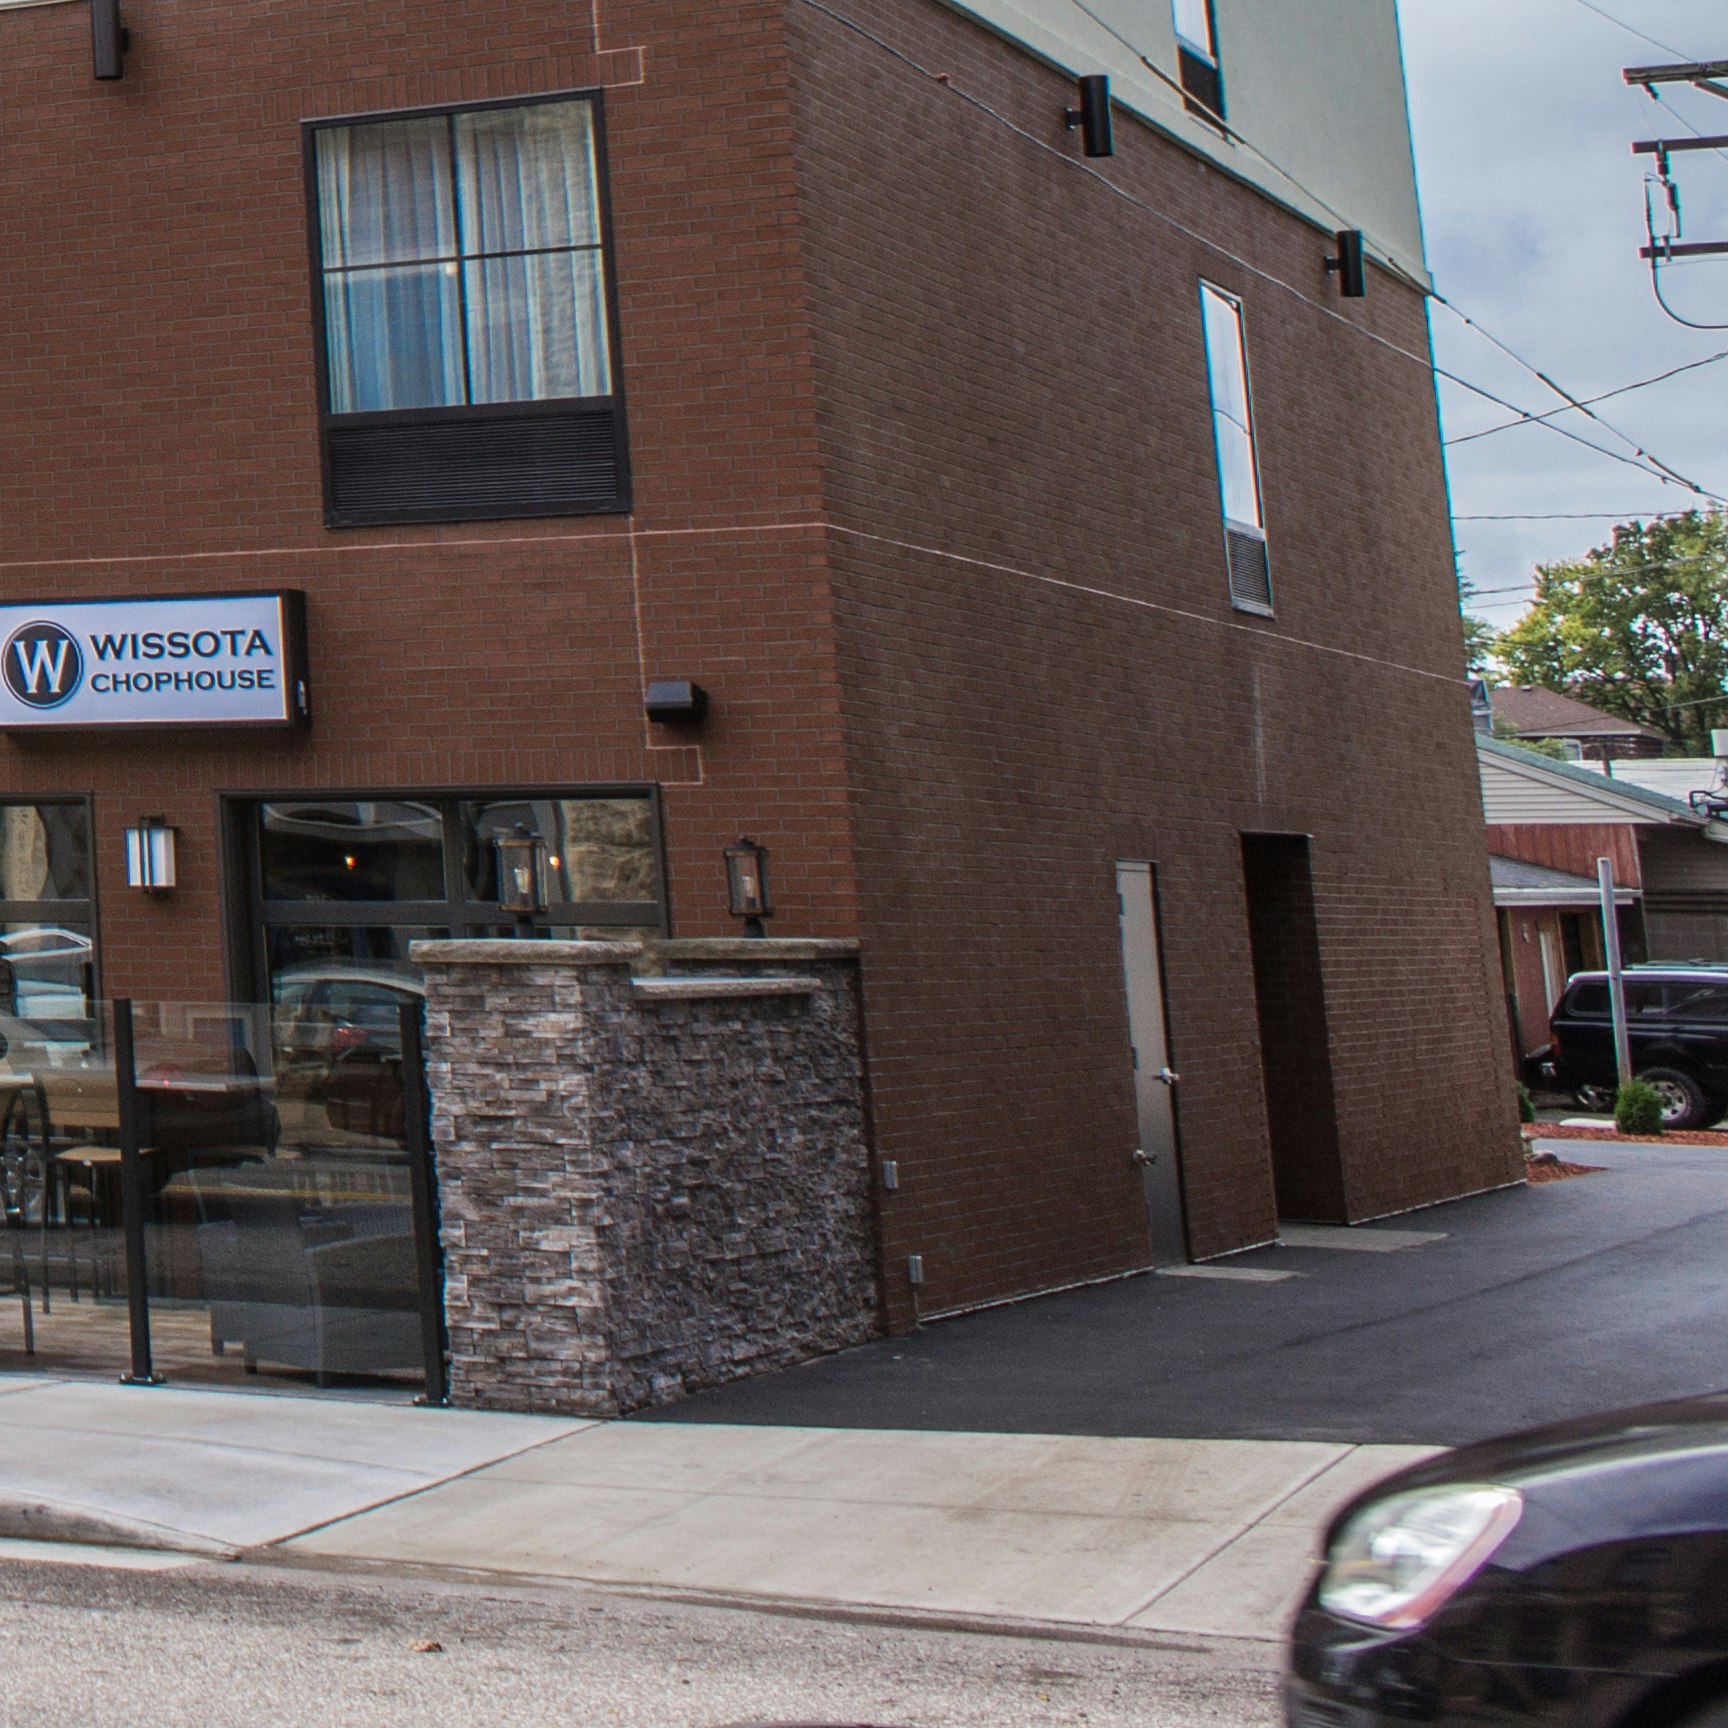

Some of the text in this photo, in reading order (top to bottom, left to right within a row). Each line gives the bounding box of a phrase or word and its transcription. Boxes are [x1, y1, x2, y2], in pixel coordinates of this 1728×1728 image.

[89, 629, 274, 661] WISSOTA
[12, 639, 69, 694] W
[90, 669, 275, 693] CHOPHOUSE
